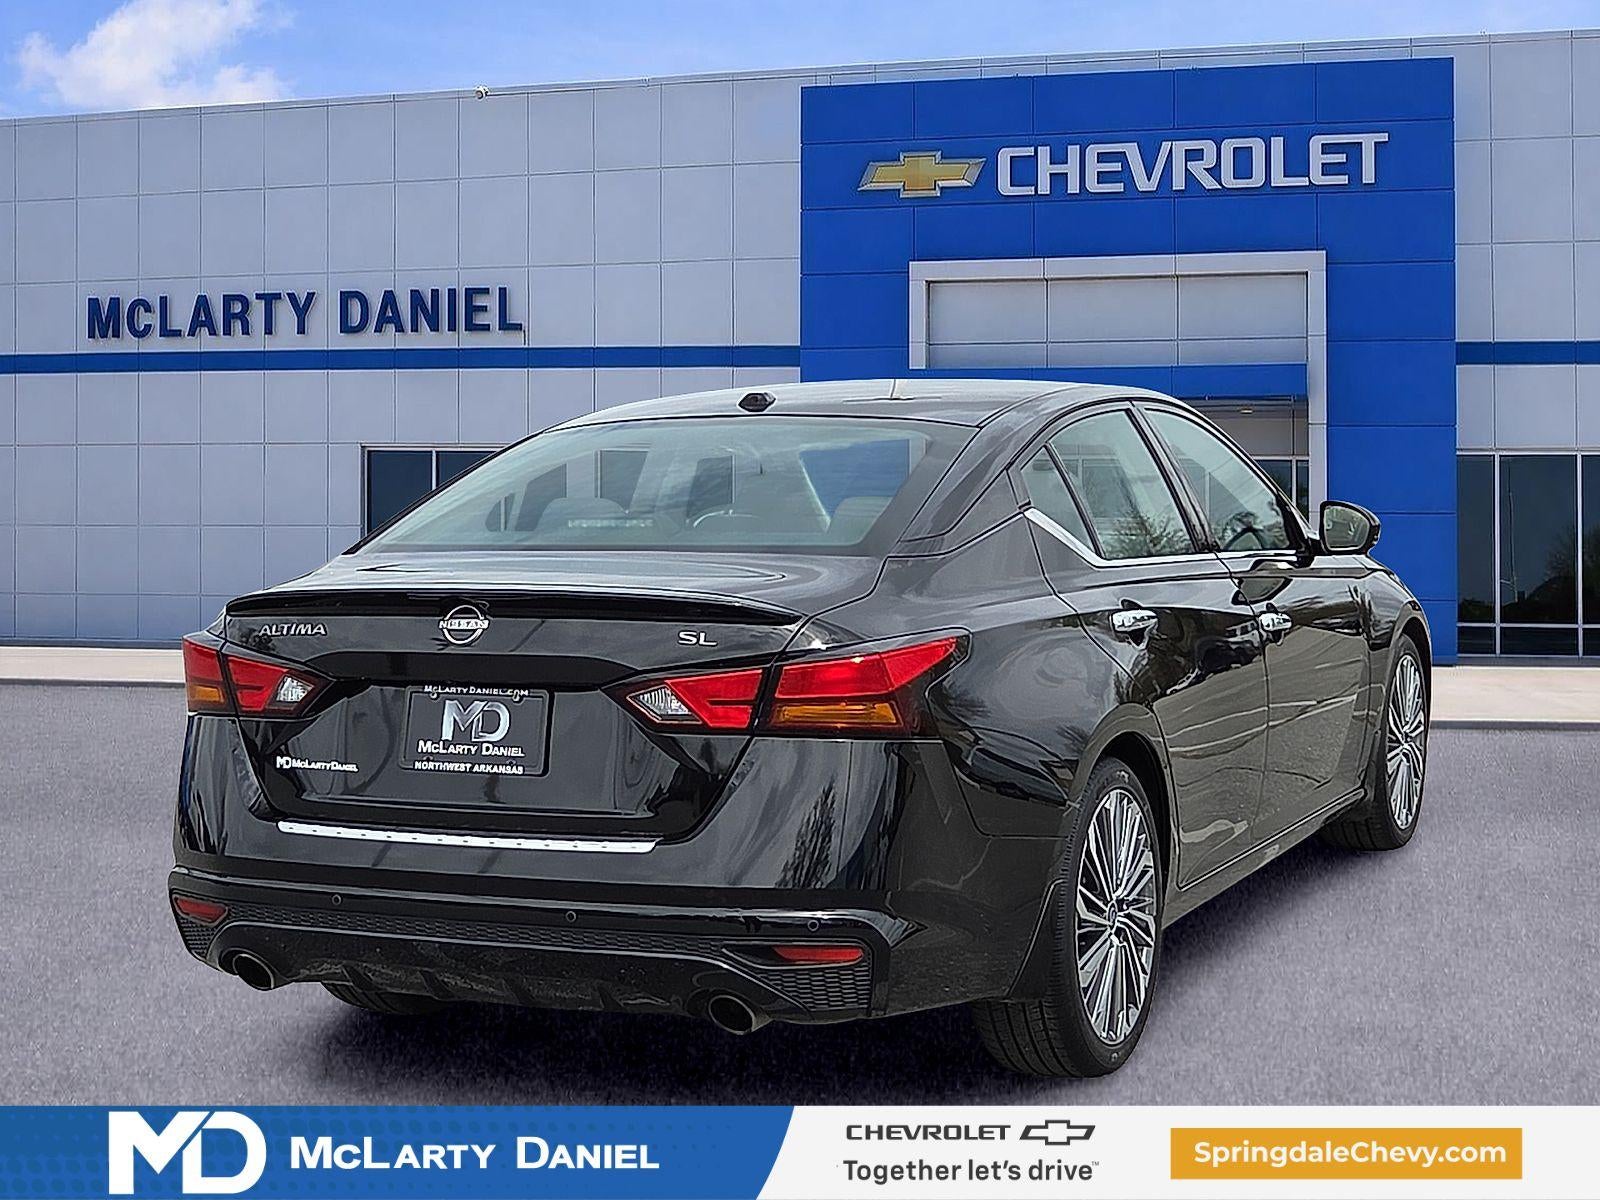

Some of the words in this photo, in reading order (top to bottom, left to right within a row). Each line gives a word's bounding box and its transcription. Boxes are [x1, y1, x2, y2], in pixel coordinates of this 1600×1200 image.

[997, 132, 1389, 196] CHEVROLET
[86, 291, 316, 340] MCLARTY
[339, 286, 524, 334] DANIEL
[259, 623, 327, 636] ALTIMA
[678, 631, 718, 645] SL
[441, 699, 510, 742] MD
[481, 742, 525, 757] DANIEL
[415, 761, 471, 773] NORTHWEST
[472, 763, 524, 775] ARKANSAS
